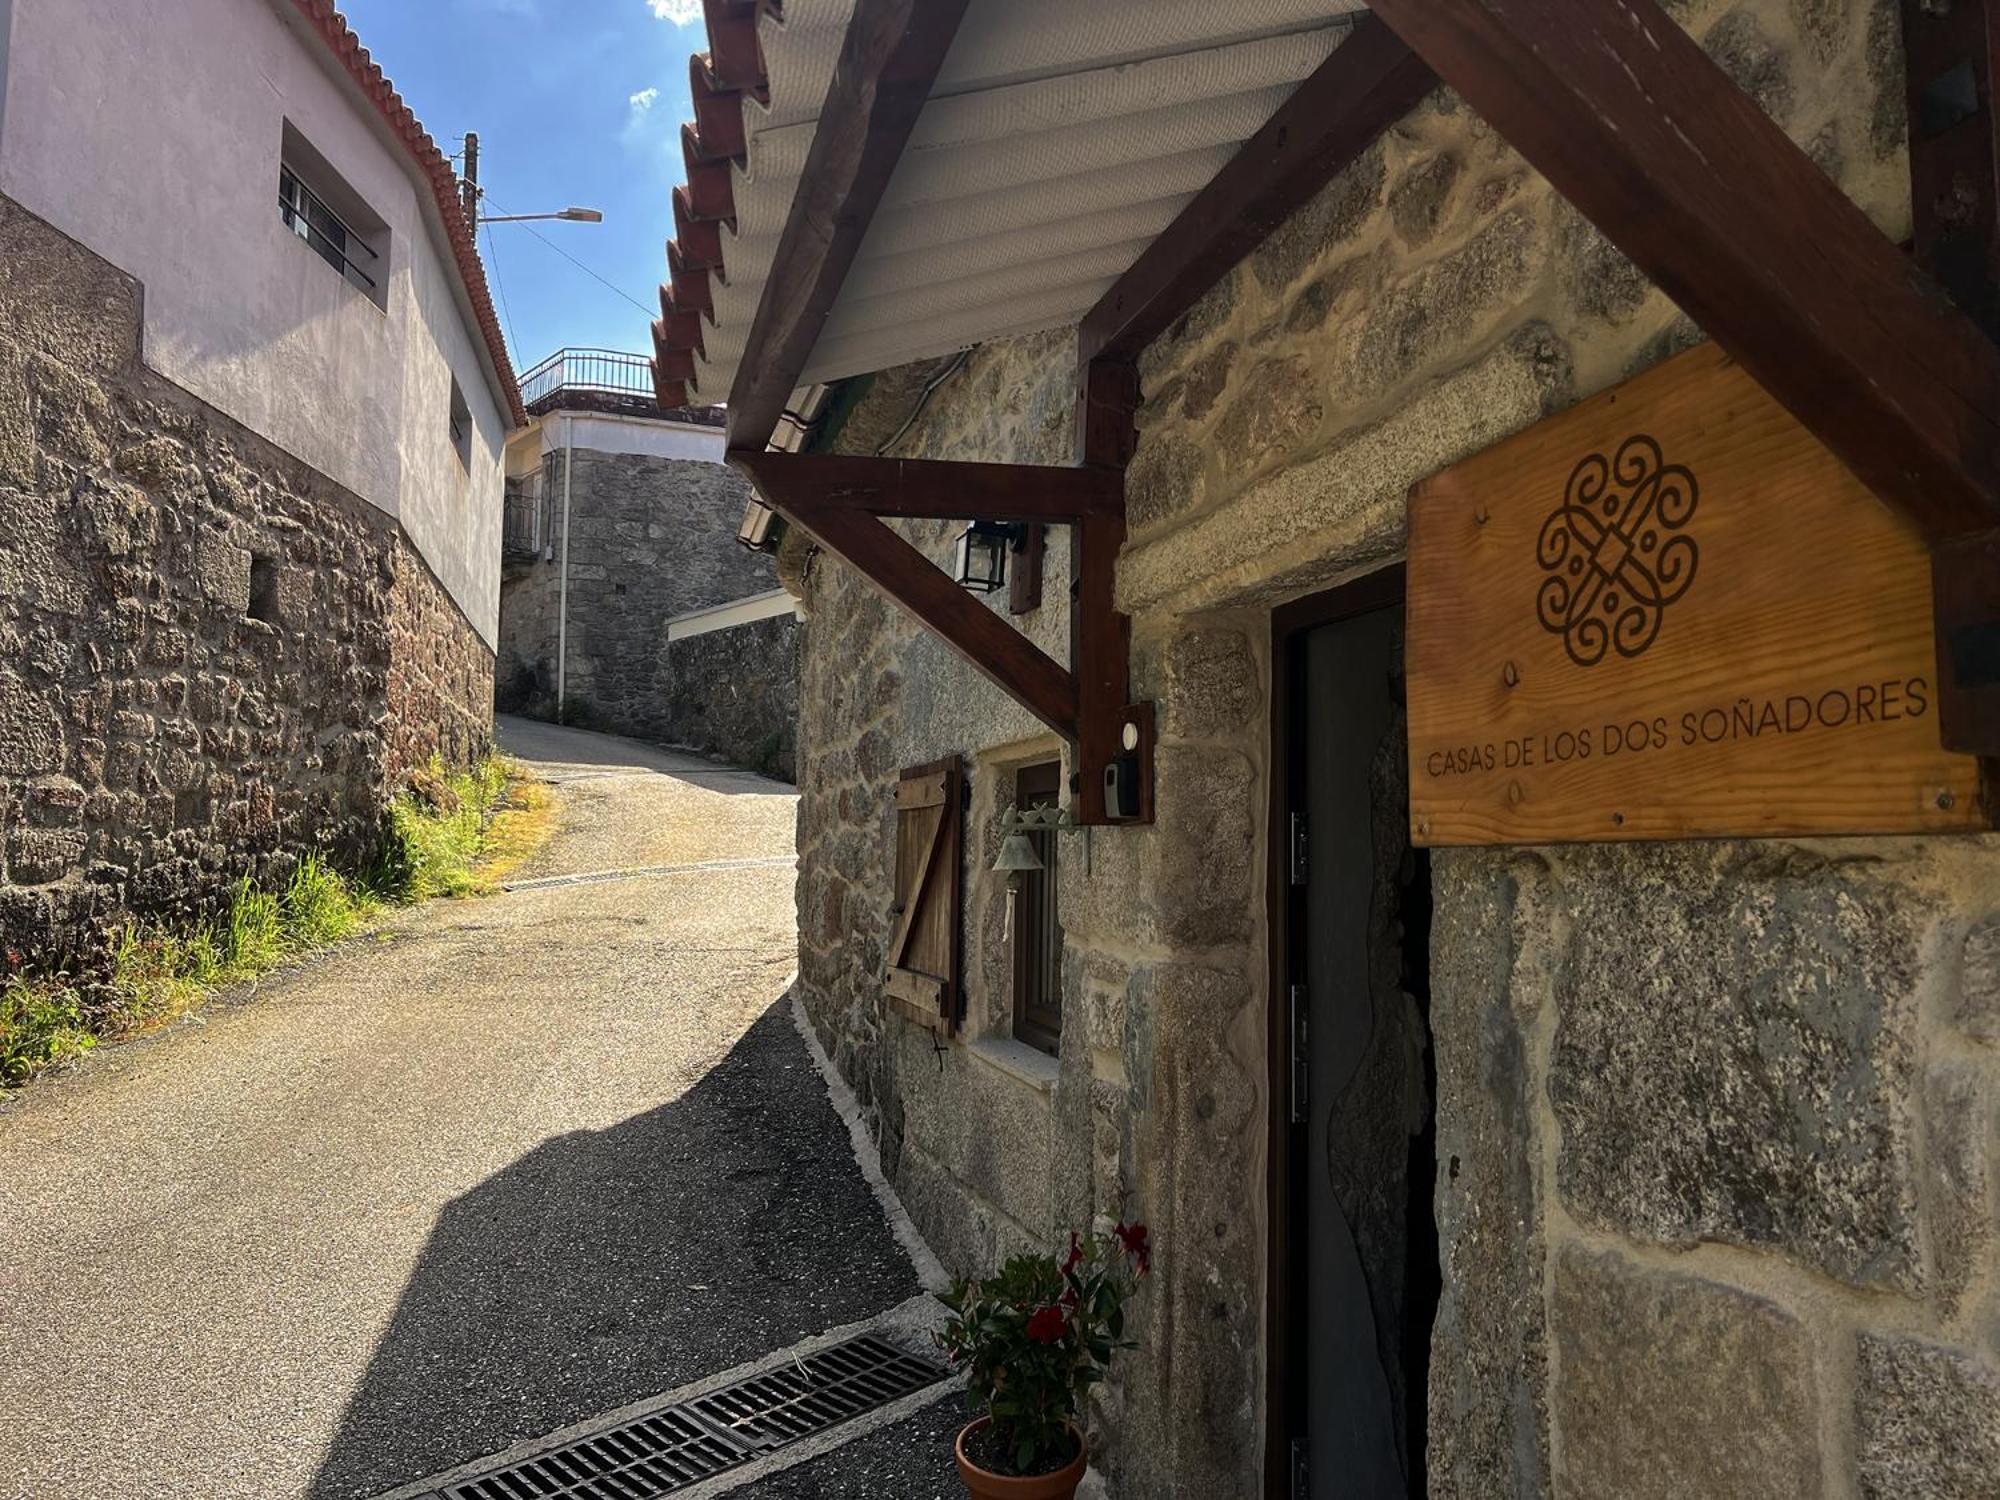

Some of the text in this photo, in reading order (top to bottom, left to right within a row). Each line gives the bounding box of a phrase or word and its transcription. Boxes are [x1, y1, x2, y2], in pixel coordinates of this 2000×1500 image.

[1427, 678, 1927, 777] CASAS DE LOS DOS SOÑADORES
